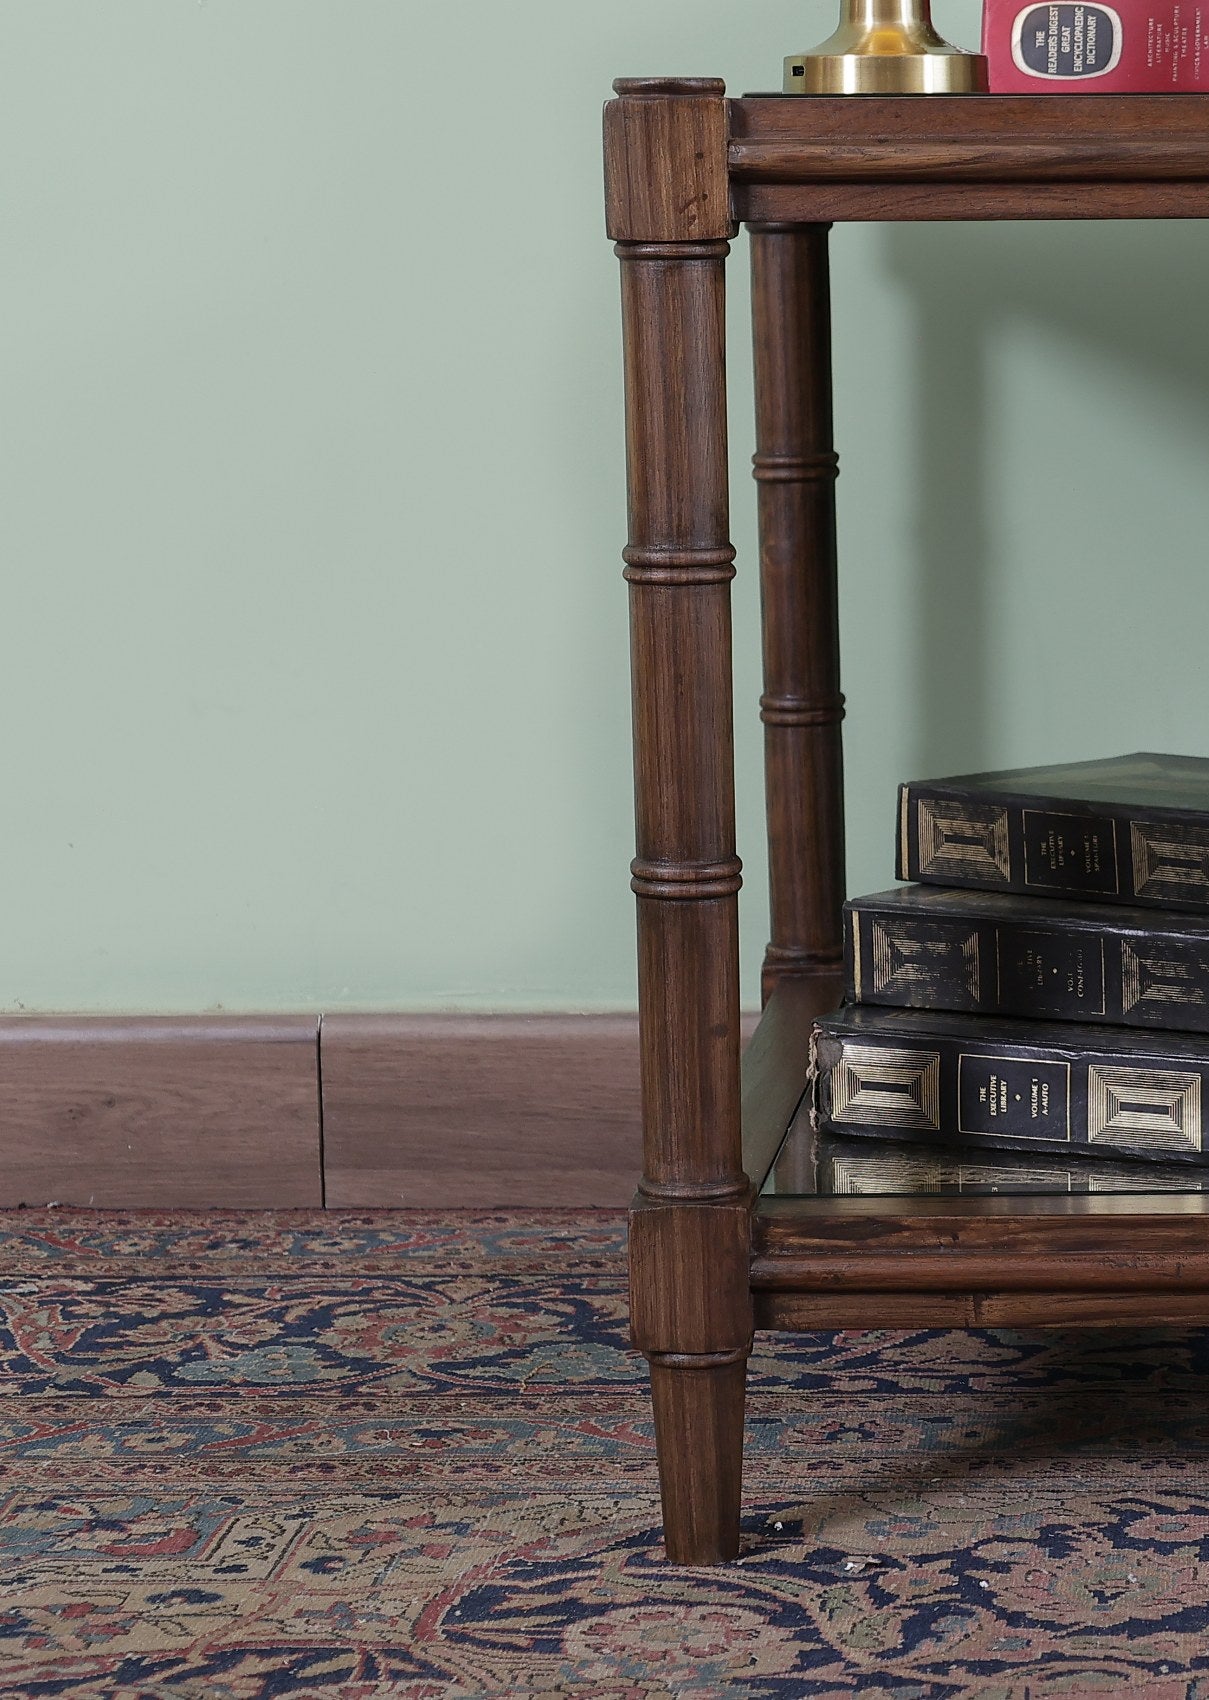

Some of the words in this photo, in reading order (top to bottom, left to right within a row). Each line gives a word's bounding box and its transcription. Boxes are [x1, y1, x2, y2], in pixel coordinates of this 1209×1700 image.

[1049, 6, 1058, 35] DIGEST
[1036, 31, 1045, 48] THE
[1047, 36, 1058, 74] READER'S
[1061, 26, 1071, 53] GREAT
[1073, 6, 1084, 72] ENCYCLOPAEDIC
[1086, 15, 1097, 65] DICTIONARY
[979, 1087, 987, 1102] THE
[989, 1074, 997, 1116] EXECUTIVE
[1000, 1080, 1008, 1113] LIBRARY
[1031, 1085, 1039, 1118] VOLUME
[1041, 1083, 1049, 1116] A-AUTO
